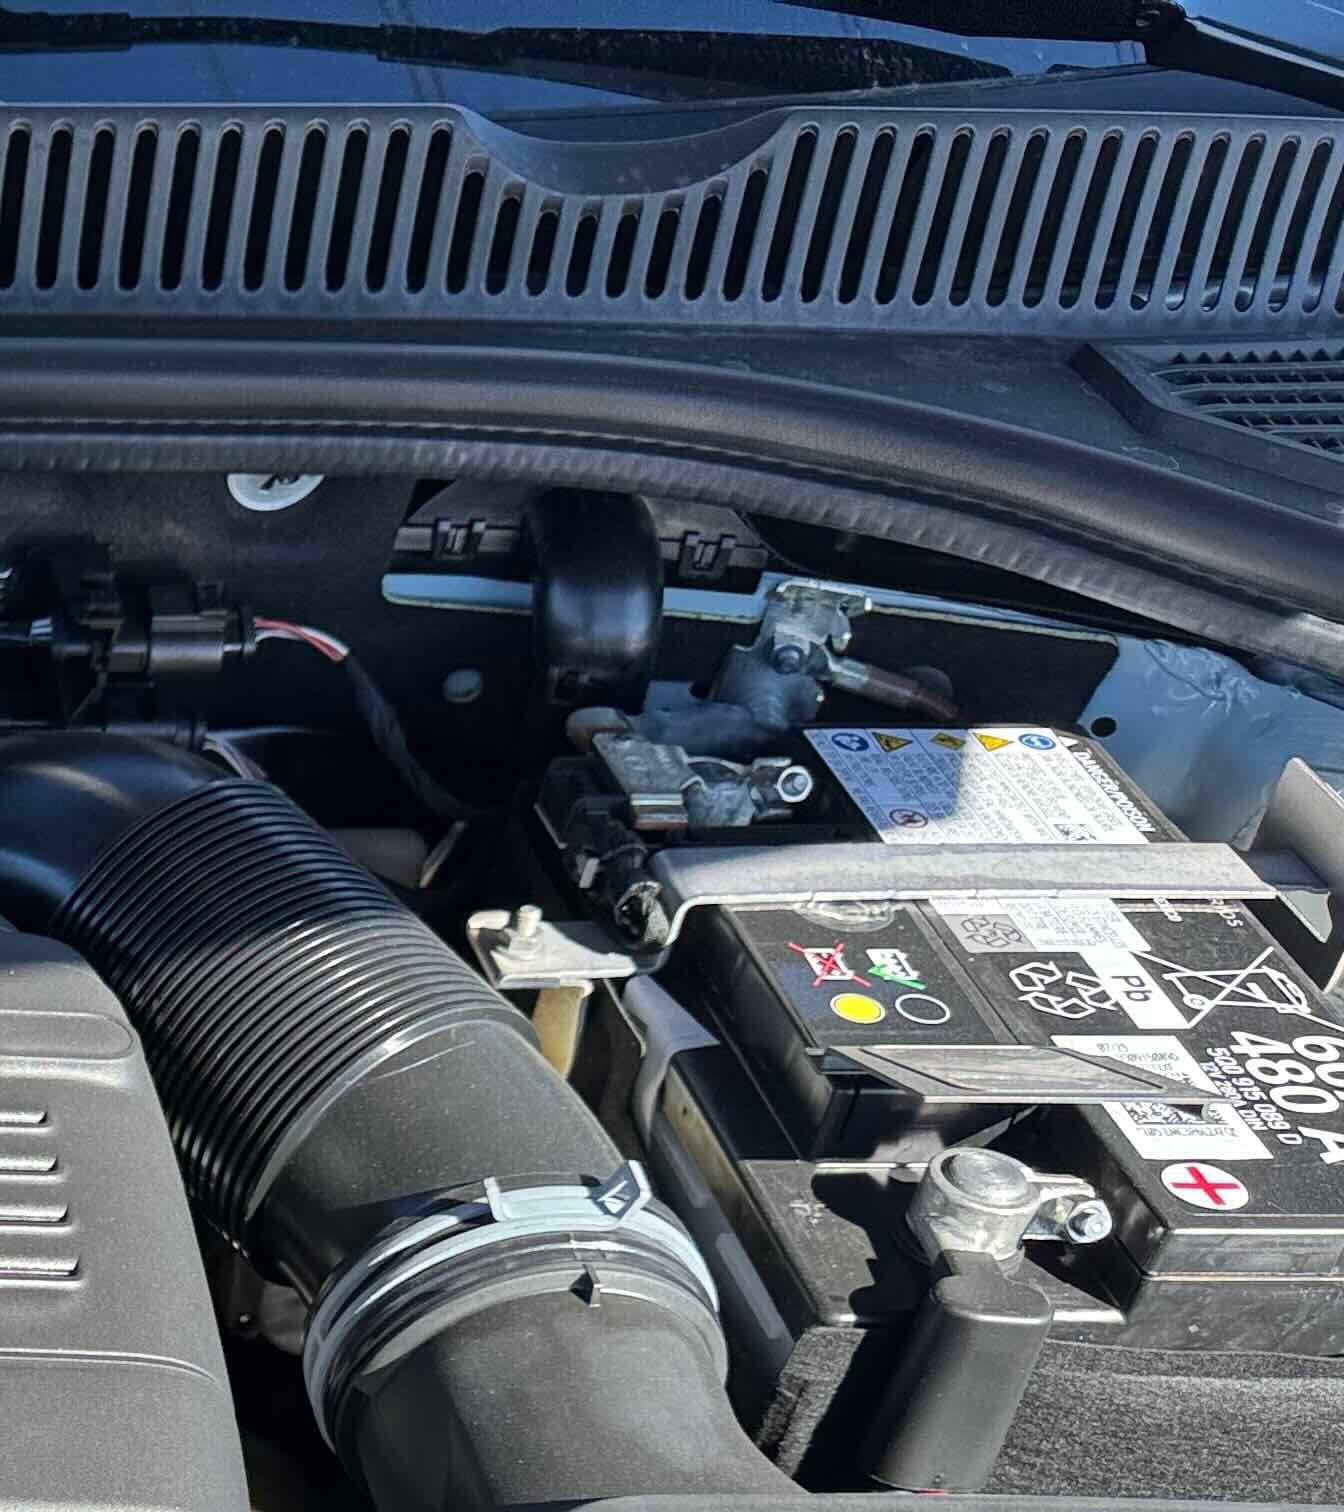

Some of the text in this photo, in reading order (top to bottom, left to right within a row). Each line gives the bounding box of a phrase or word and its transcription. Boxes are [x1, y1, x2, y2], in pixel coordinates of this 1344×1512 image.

[1110, 975, 1153, 1002] Pb
[1230, 1031, 1340, 1113] 480
[1232, 1077, 1268, 1101] 915
[1254, 1104, 1291, 1130] 089
[1277, 1133, 1303, 1145] D
